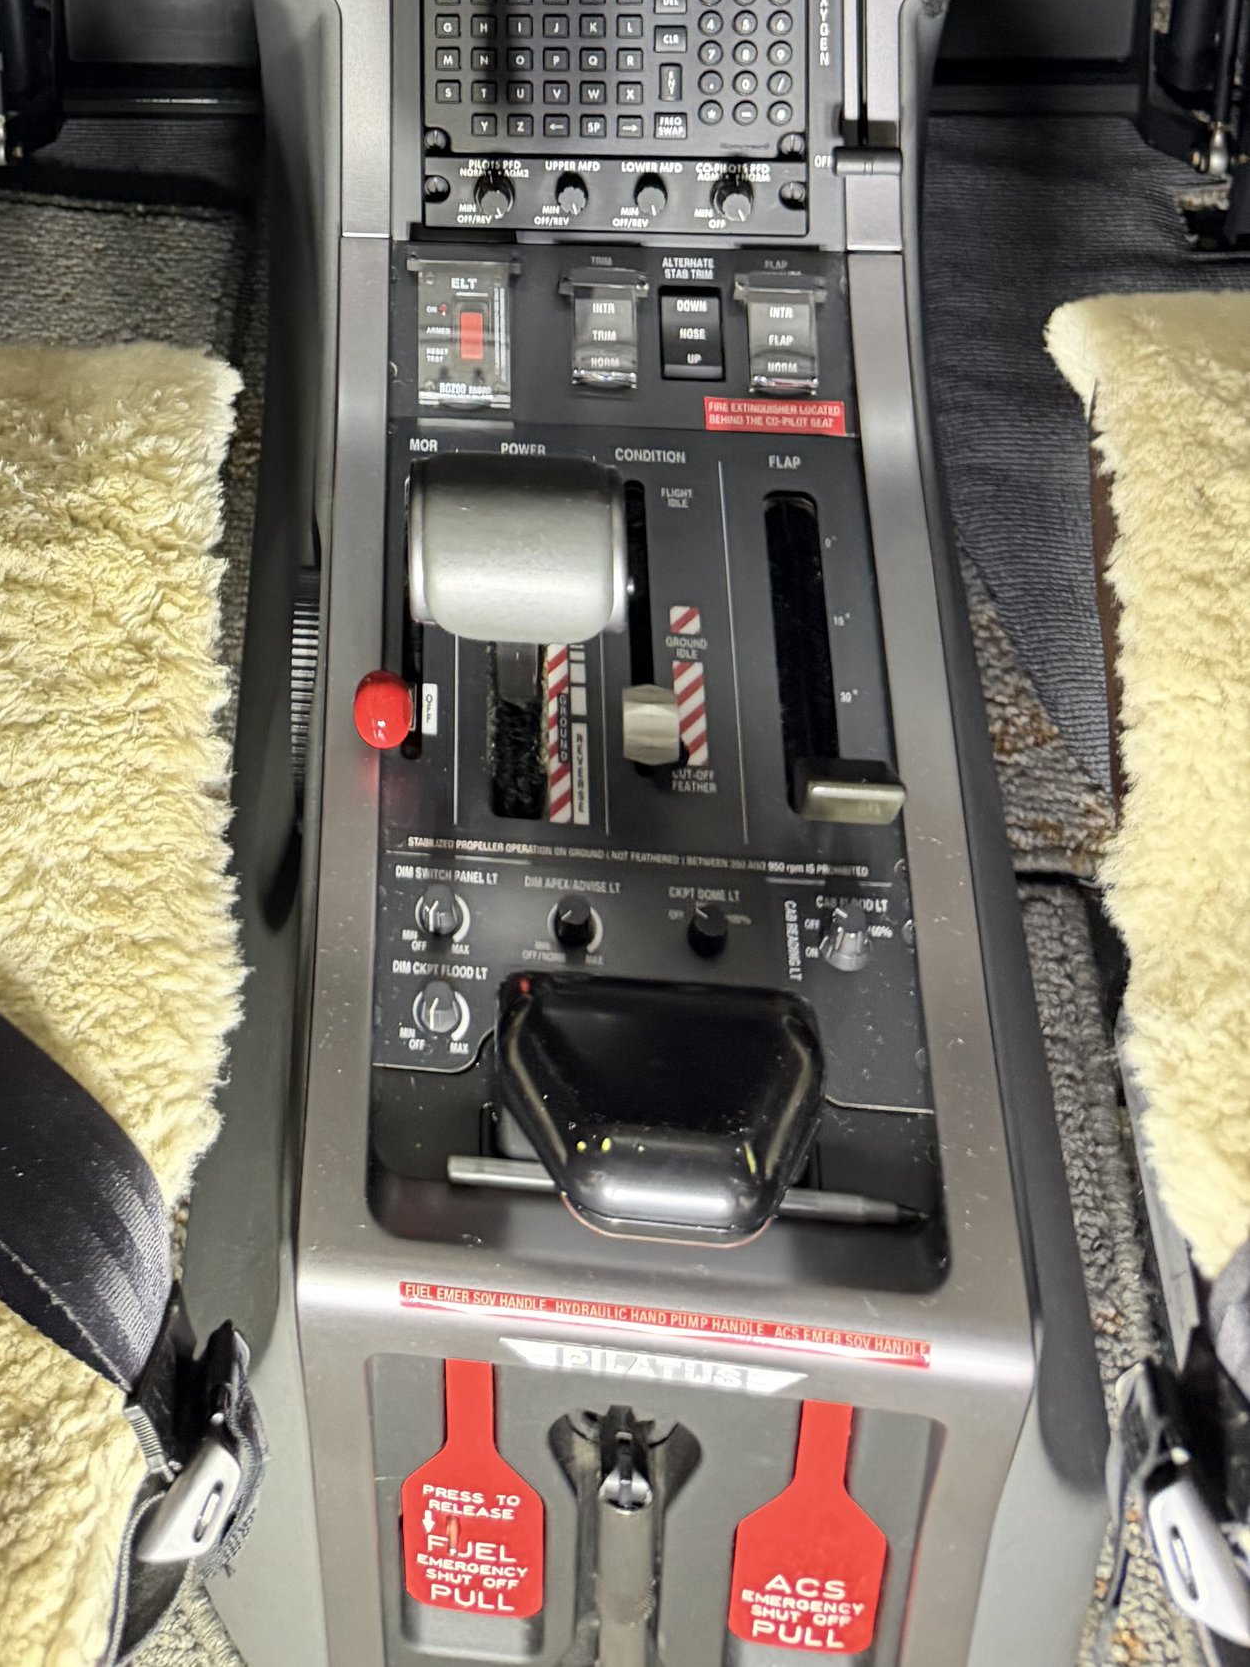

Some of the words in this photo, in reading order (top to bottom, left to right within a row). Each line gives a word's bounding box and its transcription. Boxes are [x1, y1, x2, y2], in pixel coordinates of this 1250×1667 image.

[662, 34, 679, 45] CLR
[545, 160, 576, 172] UPPER
[577, 161, 601, 172] MFD
[621, 161, 658, 173] LOWER
[659, 162, 683, 173] MFD
[814, 154, 832, 168] OFF
[662, 257, 715, 269] ALTERNATE
[664, 268, 689, 279] STAB
[690, 269, 714, 280] TRIM
[451, 277, 478, 290] ELT
[676, 299, 708, 313] DOWN
[426, 327, 451, 335] ARMED
[592, 330, 617, 342] TRIM
[679, 327, 706, 340] NOSE
[768, 334, 794, 346] FLAP
[687, 353, 702, 364] UP
[767, 361, 798, 373] NORM
[708, 401, 729, 413] FIRE
[731, 402, 798, 415] EXTINGUISHER
[798, 404, 841, 417] LOCATED
[708, 414, 744, 426] BEHIND
[746, 415, 763, 426] THE
[764, 416, 808, 428] CO-PILOT
[810, 417, 834, 429] SEAT
[409, 438, 439, 453] MOR
[500, 442, 546, 456] POWER
[614, 447, 686, 464] CONDITION
[768, 455, 801, 470] FLAP
[660, 487, 693, 499] FLIGHT
[666, 497, 689, 509] IDLE
[665, 636, 708, 650] GROUND
[676, 648, 698, 660] IDLE
[559, 694, 568, 762] GROUND
[576, 733, 585, 814] REVERSE
[671, 769, 715, 781] CUT-OFF
[671, 780, 717, 794] FEATHER
[407, 836, 454, 849] STABILIZED
[455, 839, 504, 853] PROPELLER
[505, 842, 551, 856] OPERATION
[395, 865, 414, 879] DIM
[415, 867, 452, 881] SWITCH
[454, 869, 485, 884] PANEL
[486, 872, 498, 884] LT
[784, 899, 798, 922] CAB
[411, 940, 428, 951] OFF
[786, 922, 801, 967] READING
[392, 960, 411, 974] DIM
[412, 962, 439, 975] CKPT
[441, 964, 473, 979] FLOOD
[475, 967, 488, 980] LT
[789, 967, 803, 982] LT
[408, 1039, 425, 1050] OFF
[405, 1283, 433, 1300] FUEL
[436, 1287, 470, 1304] EMER
[473, 1291, 497, 1306] SOV
[499, 1295, 547, 1311] HANDLE
[555, 1301, 627, 1321] HYDRAULIC
[630, 1308, 667, 1325] HAND
[670, 1314, 709, 1330] PUMP
[711, 1318, 765, 1336] HANDLE
[774, 1326, 800, 1341] ACS
[803, 1328, 841, 1345] EMER
[845, 1334, 872, 1350] SOV
[874, 1337, 927, 1357] HANDLE
[561, 1347, 745, 1389] PILATUS
[422, 1483, 485, 1505] PRESS
[496, 1494, 521, 1507] TO
[428, 1499, 516, 1521] RELEASE
[427, 1534, 517, 1563] FUEL
[416, 1553, 528, 1578] EMERGENCY
[425, 1568, 472, 1585] SHUT
[482, 1577, 520, 1590] OFF
[764, 1574, 847, 1601] ACS
[430, 1583, 516, 1612] PULL
[741, 1589, 866, 1616] EMERGENCY
[750, 1604, 802, 1624] SHUT
[812, 1613, 853, 1628] OFF
[751, 1619, 846, 1649] PULL
